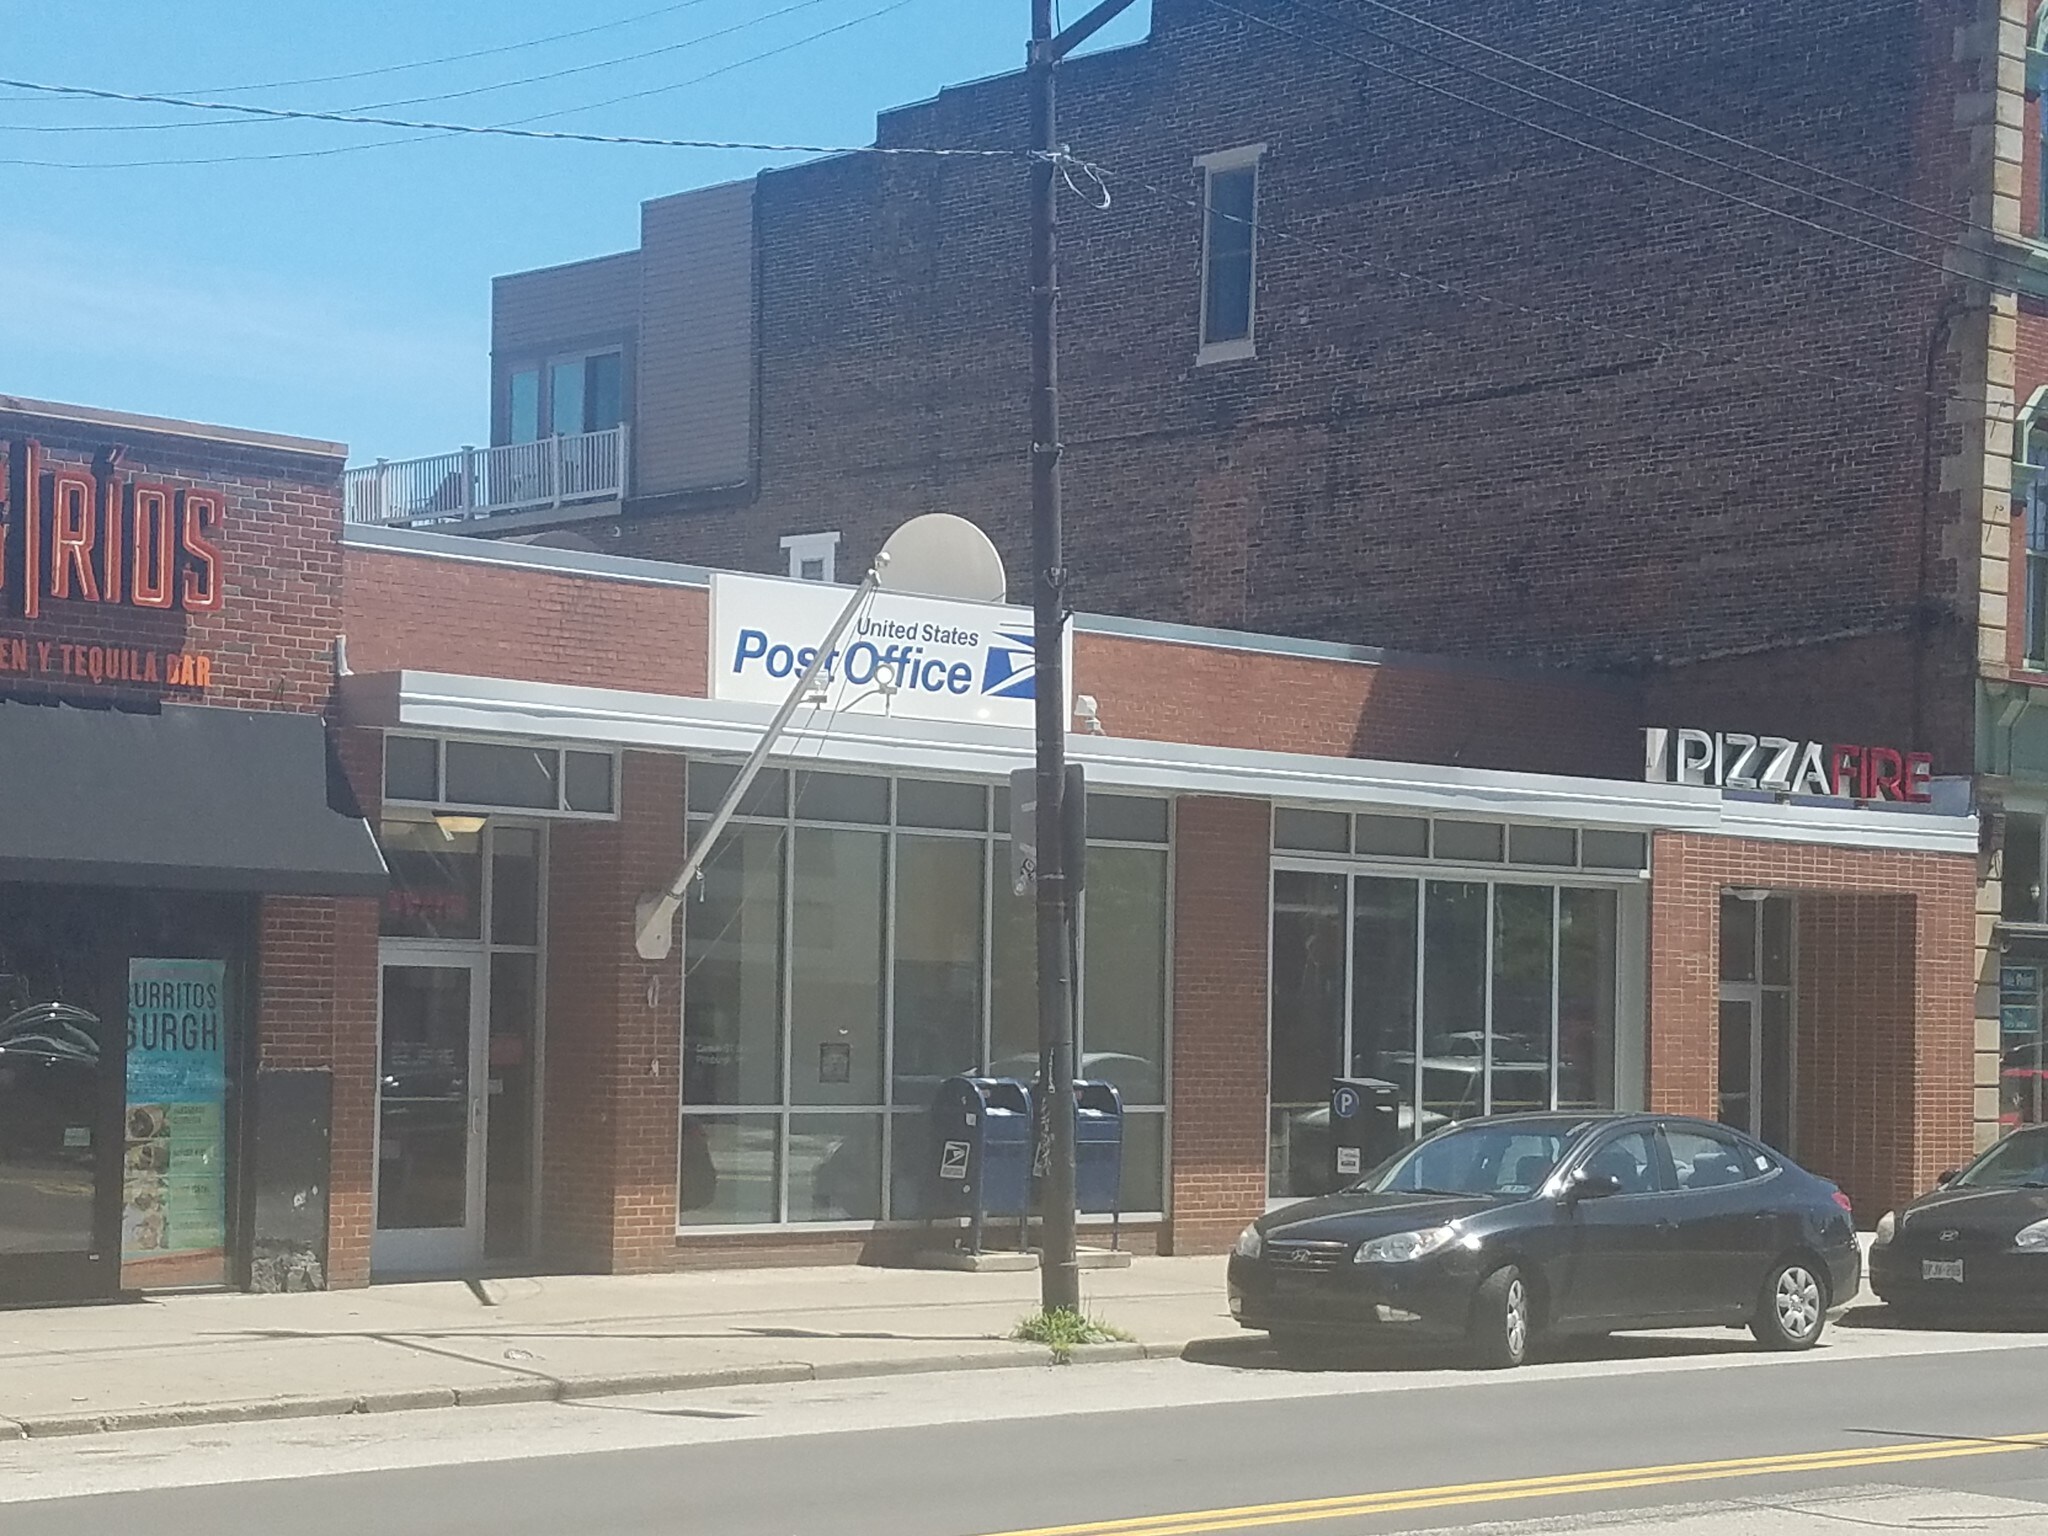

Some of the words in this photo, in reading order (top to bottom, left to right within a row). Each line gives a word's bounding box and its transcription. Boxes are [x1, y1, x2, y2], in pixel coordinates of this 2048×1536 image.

[857, 617, 918, 640] United
[922, 623, 979, 647] States
[37, 641, 51, 672] Y
[60, 644, 158, 684] TEQUILA
[167, 653, 211, 687] BAR
[844, 641, 972, 694] Office
[1341, 1093, 1353, 1113] P
